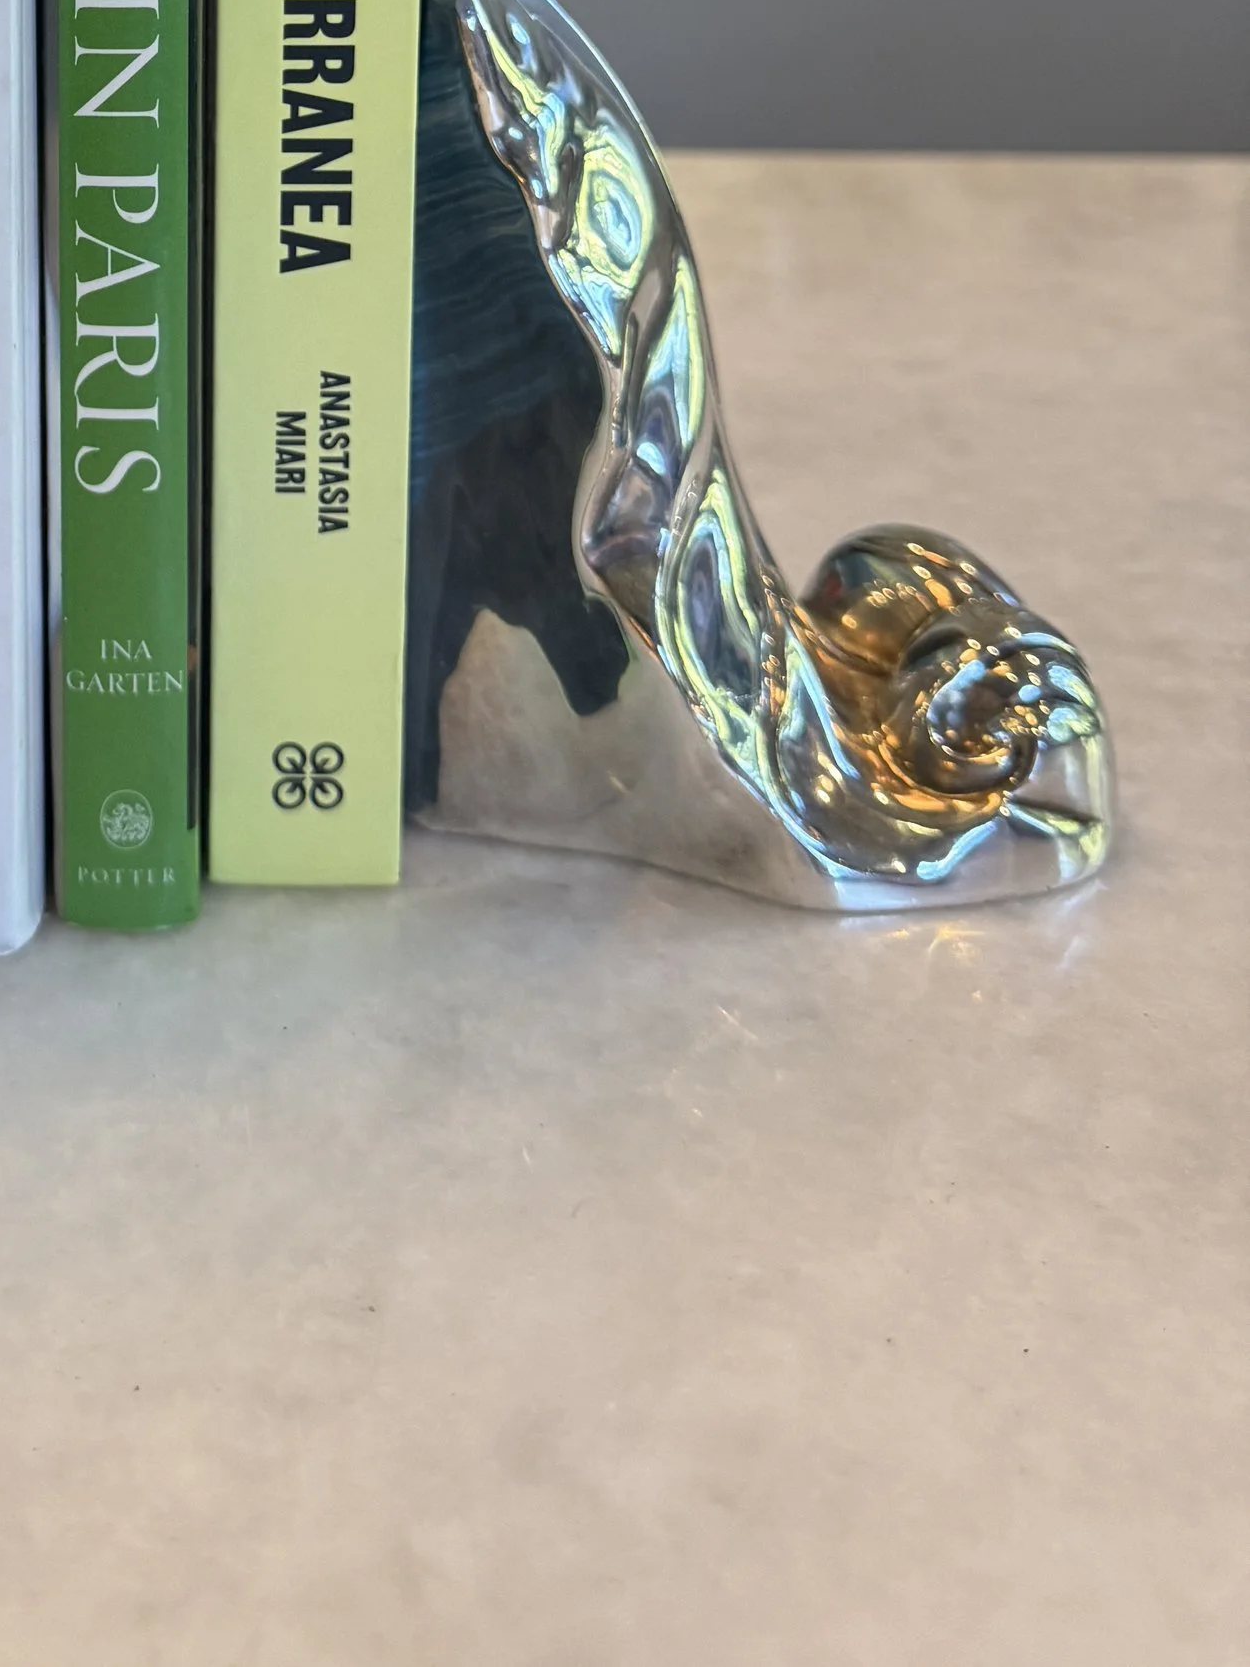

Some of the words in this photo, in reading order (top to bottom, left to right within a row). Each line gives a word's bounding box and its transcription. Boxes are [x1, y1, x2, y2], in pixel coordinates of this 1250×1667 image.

[73, 163, 162, 494] PARIS
[275, 411, 307, 493] MIARI
[317, 370, 352, 534] ANASTASIA
[100, 639, 152, 661] INA
[65, 670, 184, 694] GARTEN
[77, 866, 176, 887] POTTER
